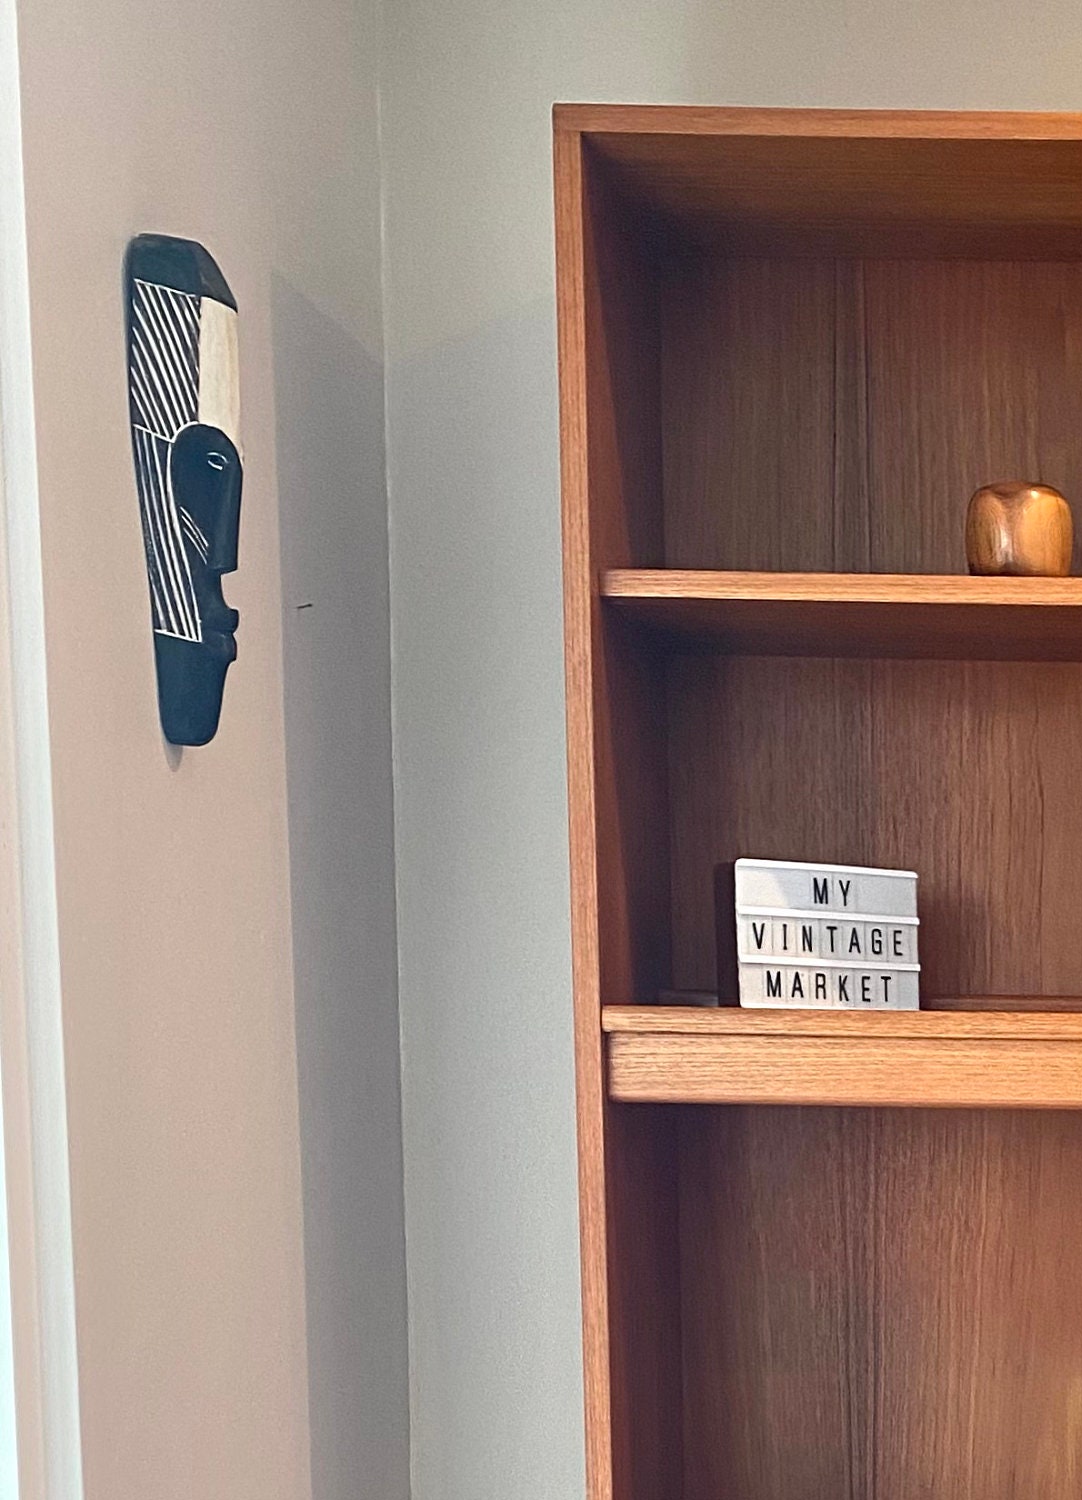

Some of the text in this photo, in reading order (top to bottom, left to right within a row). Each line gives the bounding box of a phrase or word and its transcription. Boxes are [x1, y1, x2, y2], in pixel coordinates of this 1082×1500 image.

[813, 877, 851, 906] MY
[752, 922, 903, 956] VINTAGE
[766, 970, 892, 1002] MARKET
